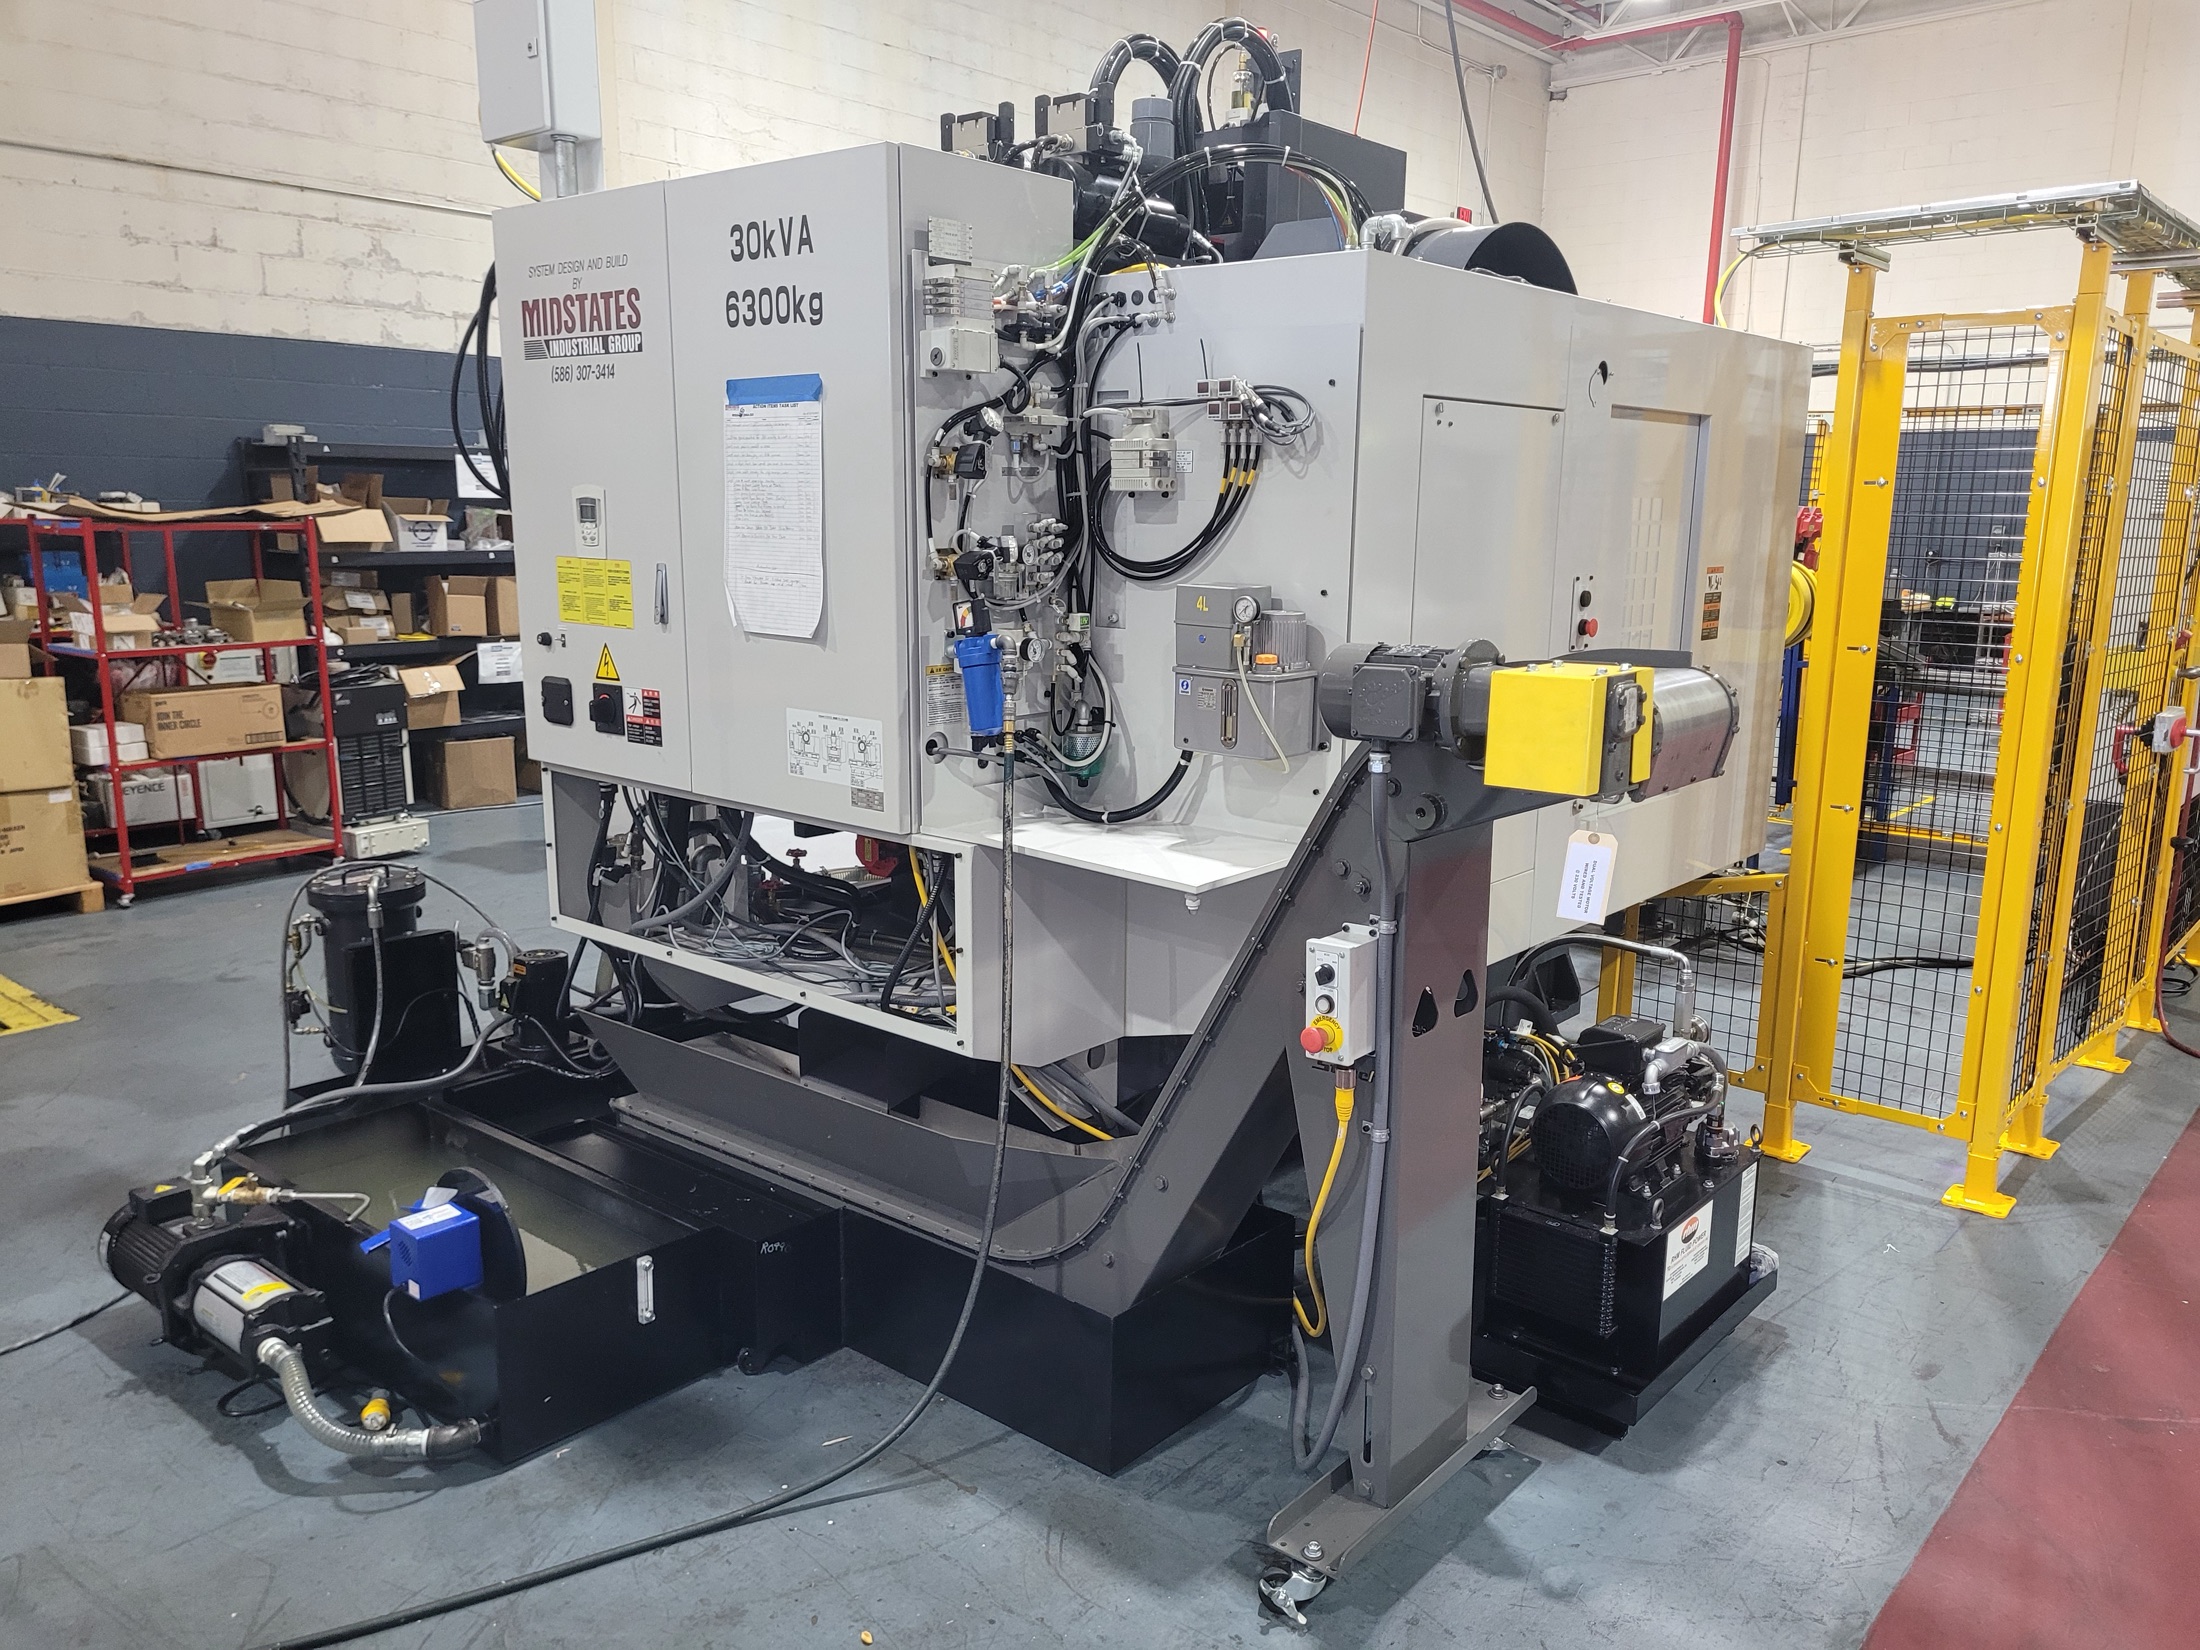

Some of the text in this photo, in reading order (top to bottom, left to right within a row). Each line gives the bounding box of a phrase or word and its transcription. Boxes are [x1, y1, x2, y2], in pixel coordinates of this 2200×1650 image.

[729, 214, 814, 262] 30kVA
[528, 254, 628, 278] SYSTEM DESIGN AND BUILD
[572, 277, 582, 290] BY
[521, 287, 641, 338] MIDSTATES
[726, 285, 823, 328] 6300kg
[549, 333, 641, 357] INDUSTRIAL GROUP
[551, 363, 615, 384] (586) 307-3414
[1196, 595, 1209, 612] 4L
[172, 710, 184, 720] THE
[179, 719, 202, 729] CIRCLE
[123, 783, 165, 796] EYENCE
[1313, 1015, 1341, 1030] EMERGENCY
